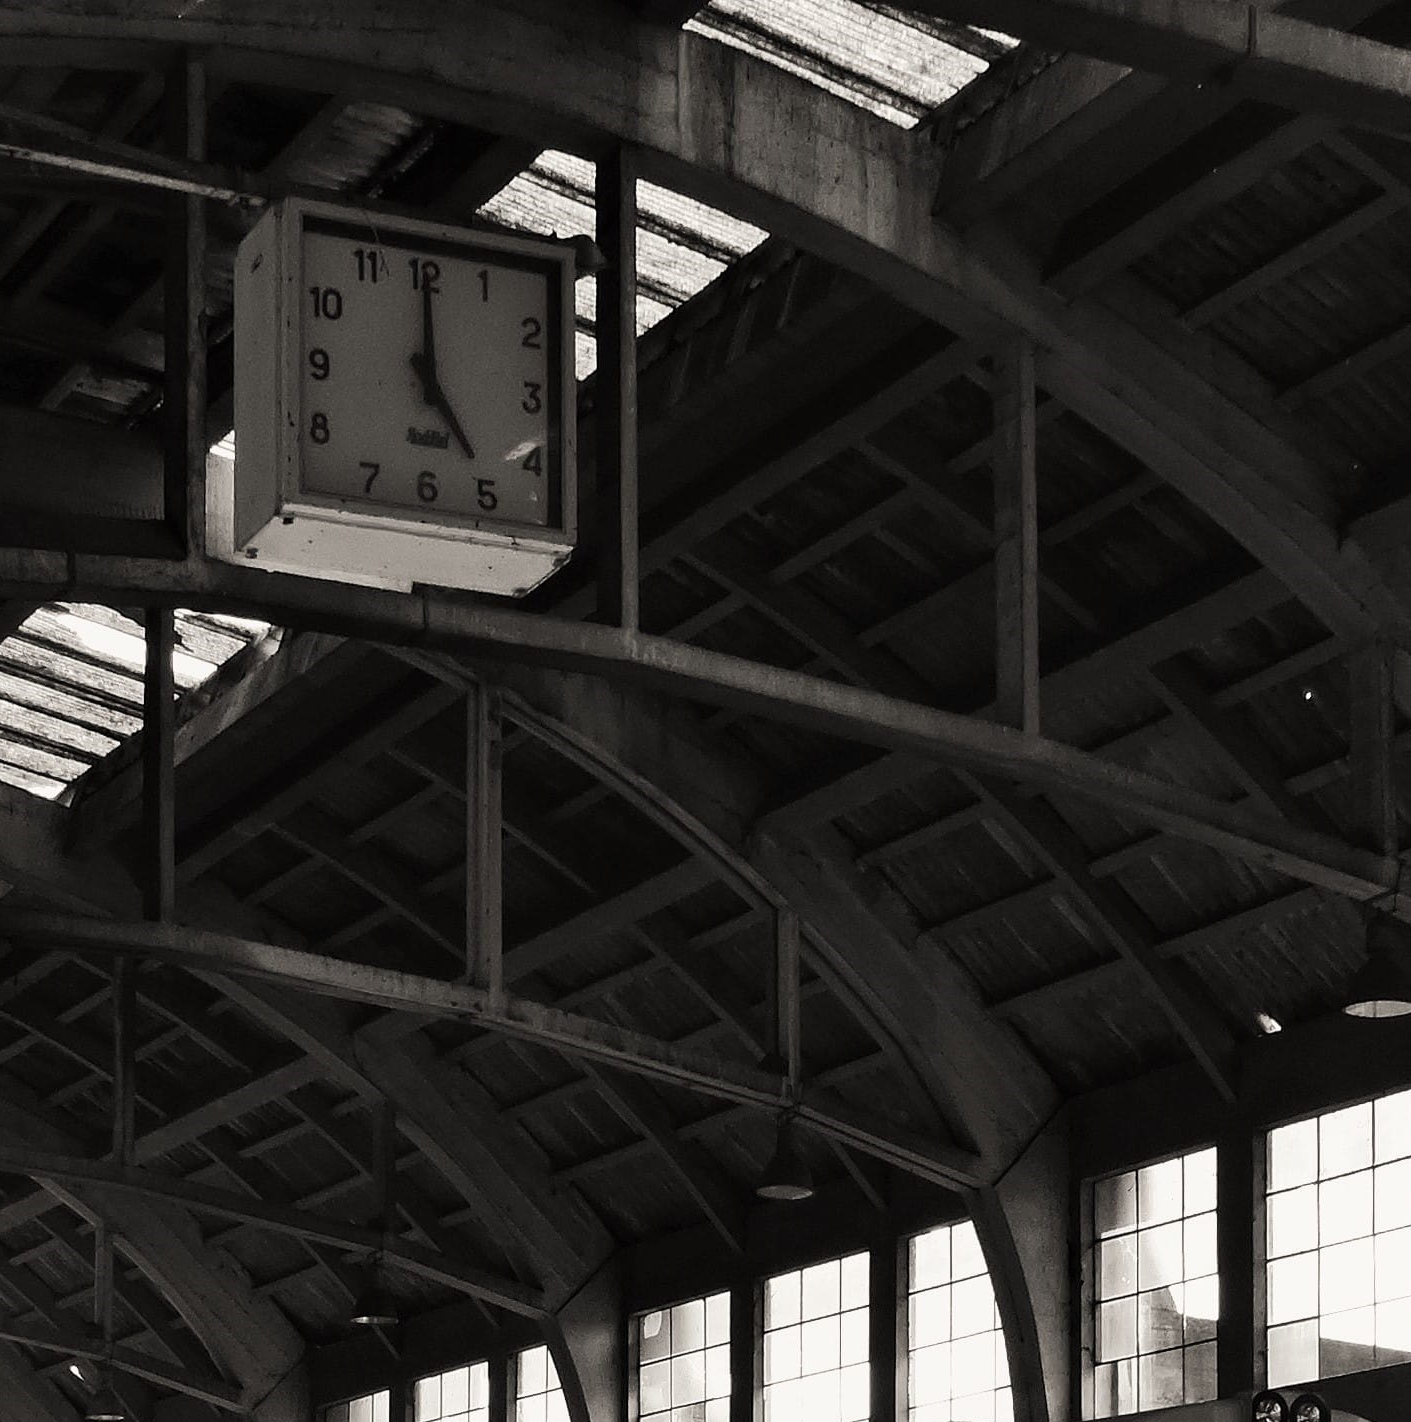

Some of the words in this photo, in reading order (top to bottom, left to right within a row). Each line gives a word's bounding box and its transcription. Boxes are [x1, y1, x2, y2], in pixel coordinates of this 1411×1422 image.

[353, 249, 379, 284] 11
[408, 257, 441, 294] 12
[476, 269, 490, 303] 1
[308, 286, 343, 321] 10
[521, 317, 542, 350] 2
[308, 348, 331, 381] 9
[521, 381, 543, 415] 3
[309, 412, 331, 445] 8
[358, 461, 381, 494] 7
[522, 445, 543, 477] 4
[416, 470, 439, 503] 6
[475, 477, 498, 511] 5
